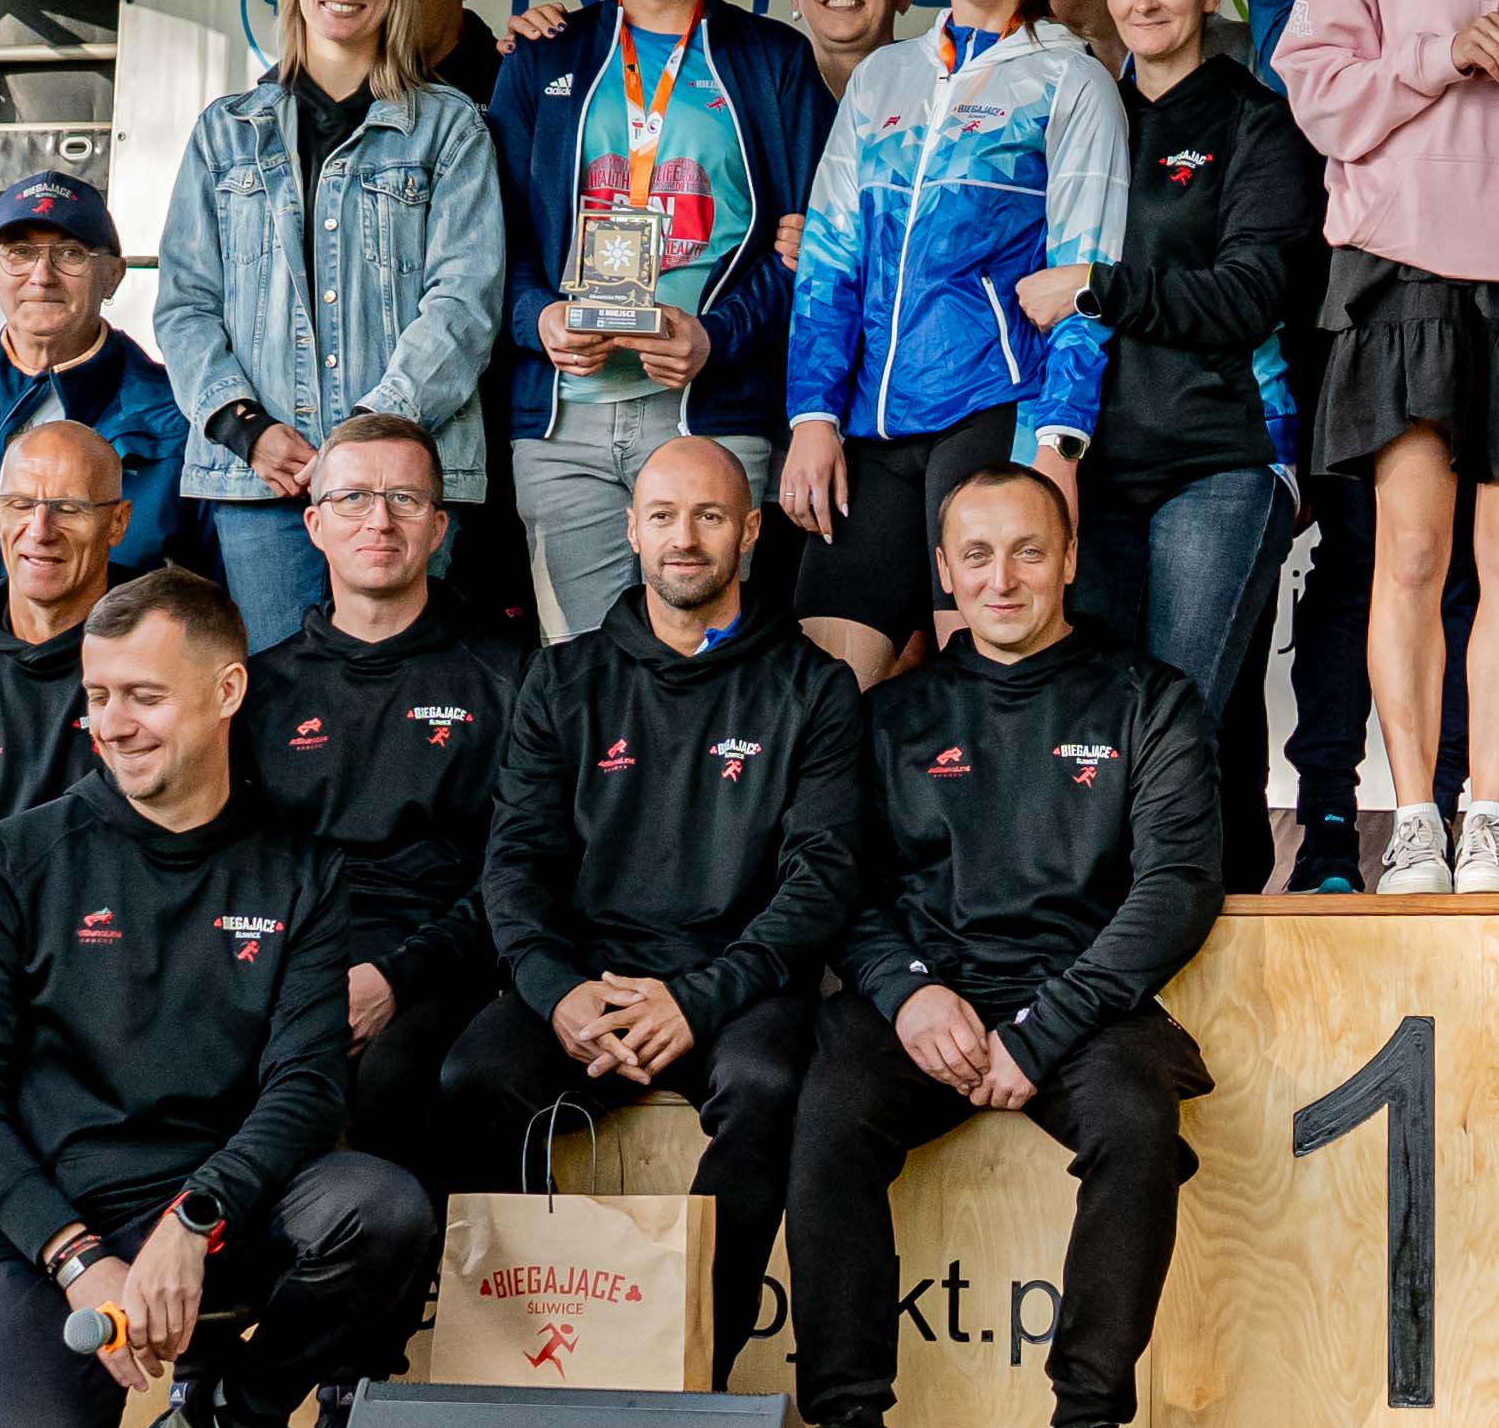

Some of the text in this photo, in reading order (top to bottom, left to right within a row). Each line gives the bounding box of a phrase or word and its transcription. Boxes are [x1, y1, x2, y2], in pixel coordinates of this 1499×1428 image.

[1291, 1014, 1436, 1409] 1
[492, 1265, 626, 1304] BIEGAJĄCE
[527, 1299, 584, 1315] ŚLIWICE
